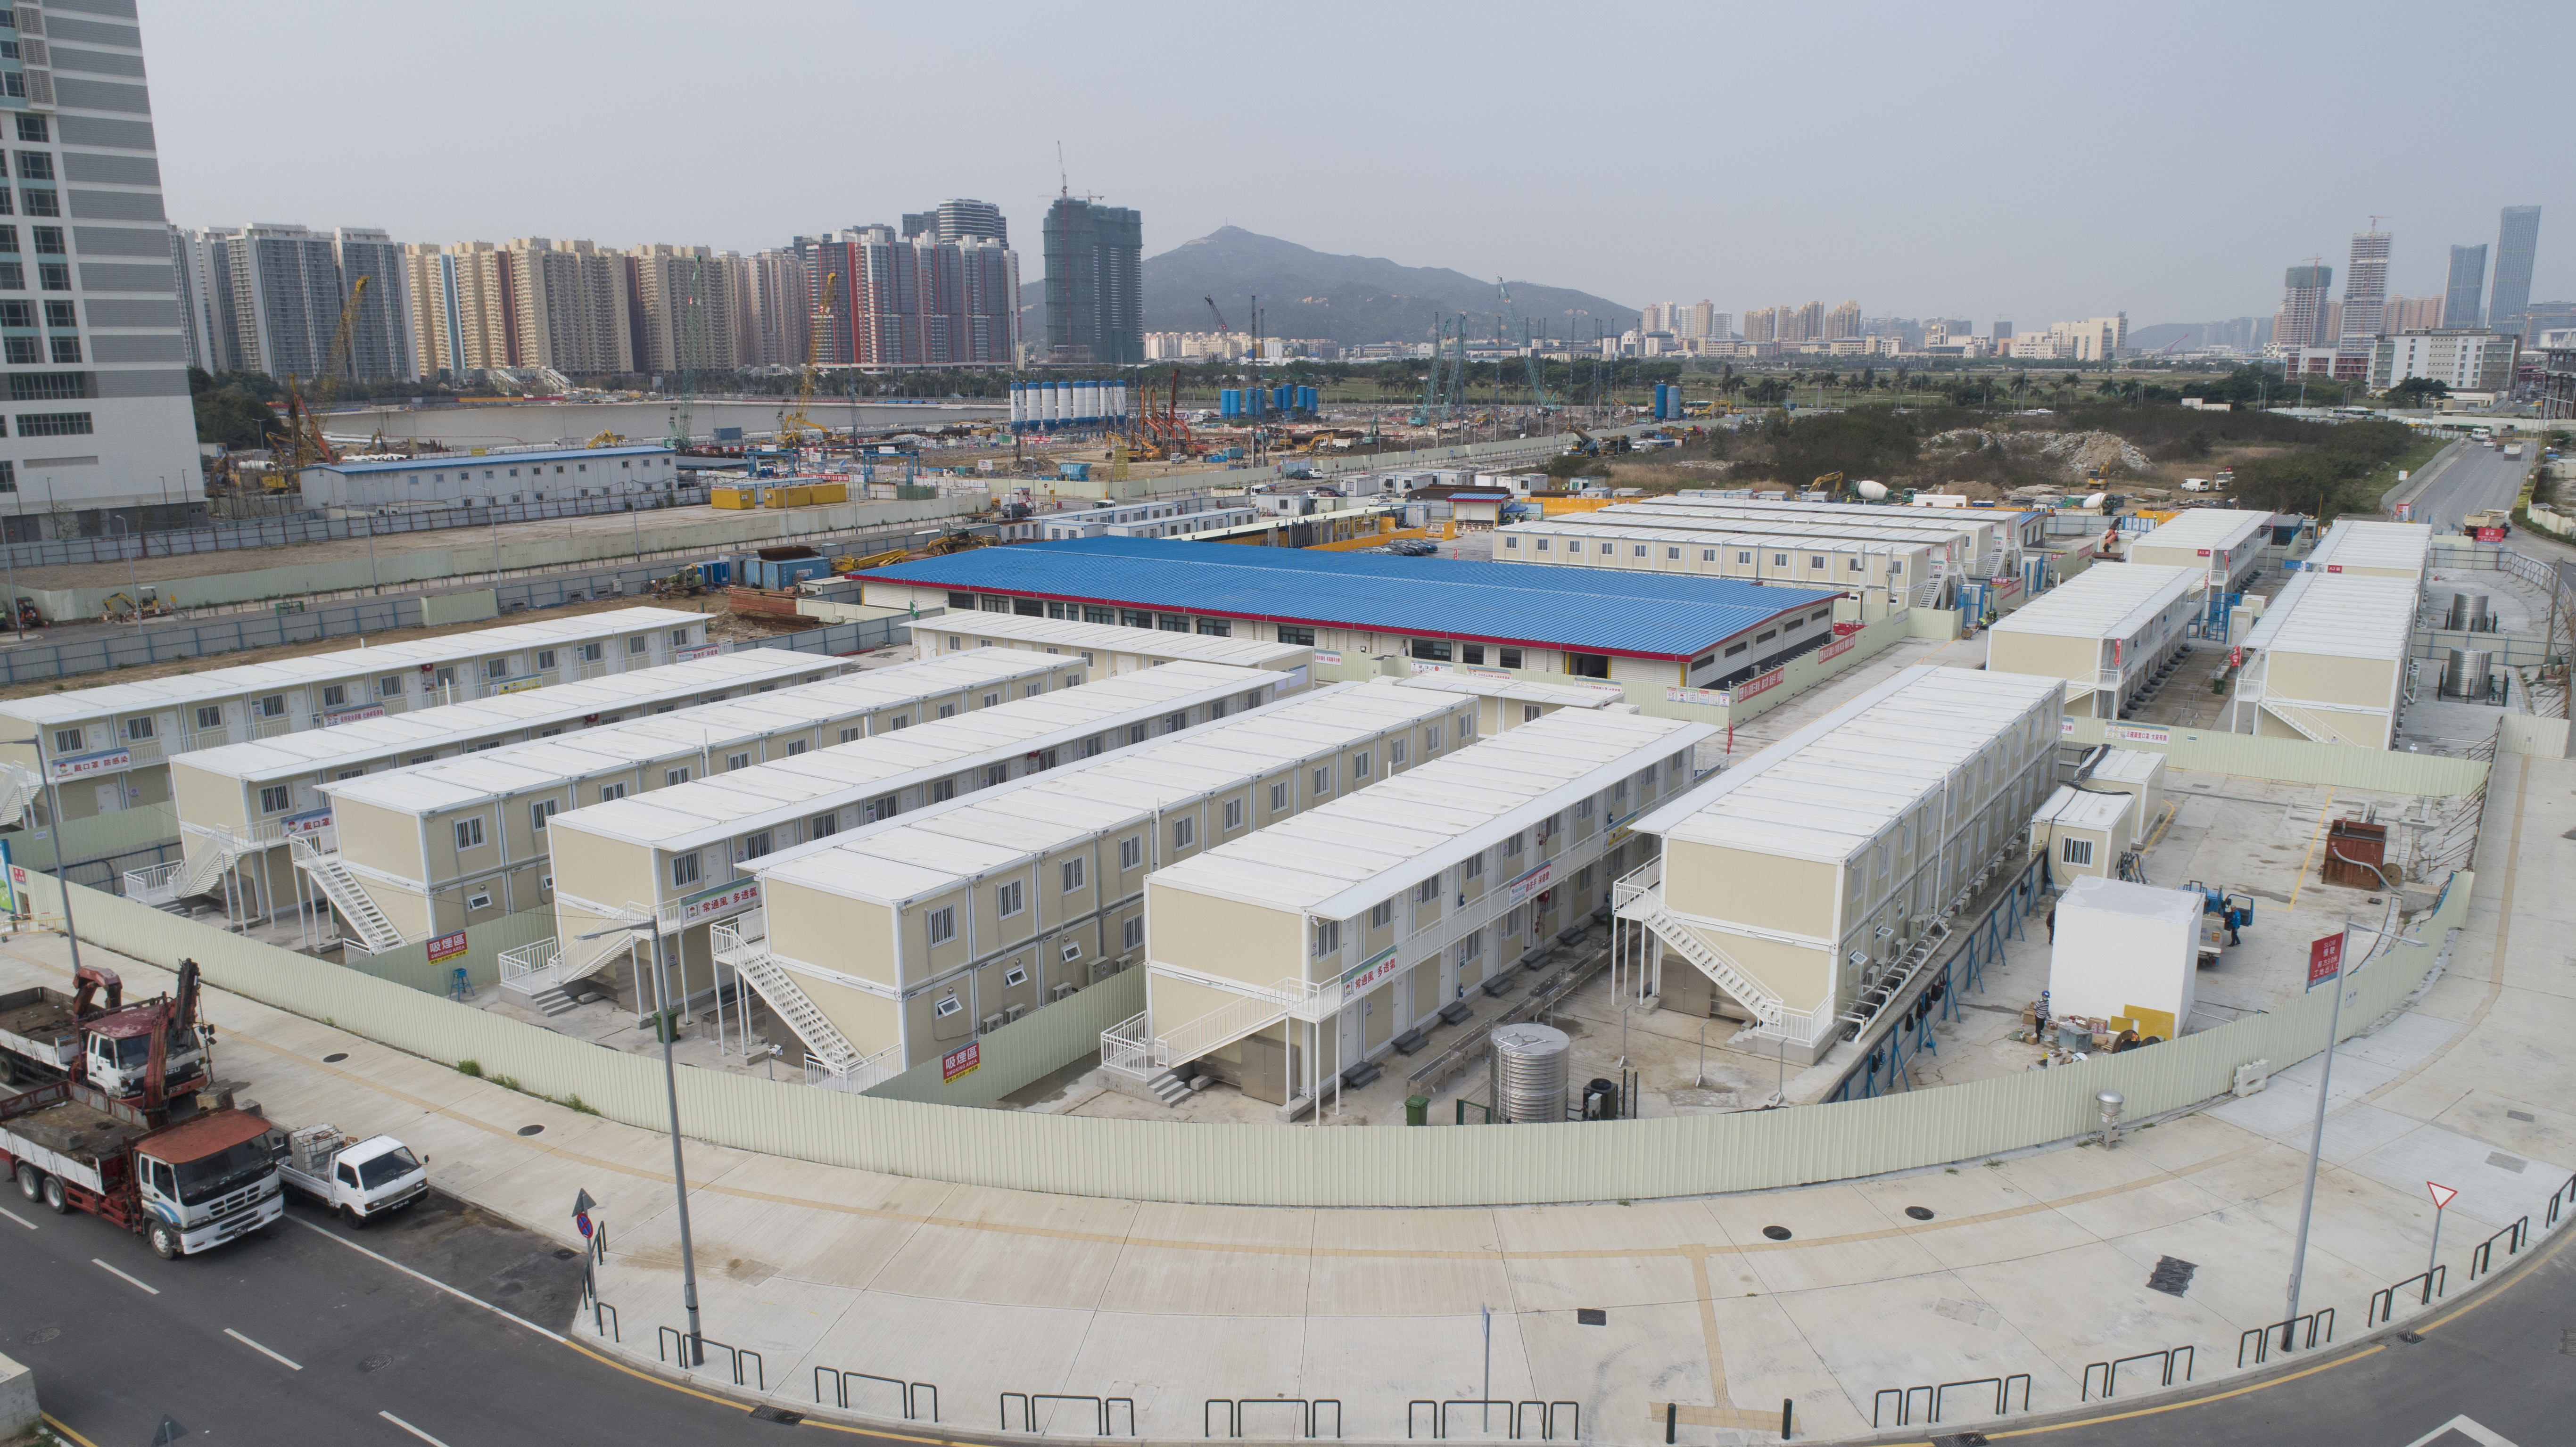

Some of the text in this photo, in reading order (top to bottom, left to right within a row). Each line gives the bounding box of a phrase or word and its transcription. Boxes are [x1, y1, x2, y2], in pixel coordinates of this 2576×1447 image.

[74, 755, 129, 772] 戴口罩 防感染
[304, 817, 330, 830] 戴口罩
[702, 887, 758, 913] 常通風 多透氣
[429, 934, 465, 953] 吸煙區
[431, 949, 453, 959] SMOKING
[1355, 958, 1395, 989] 常通風 多透氣
[945, 1045, 978, 1069] 吸煙區
[947, 1059, 977, 1077] SMOKING AREA
